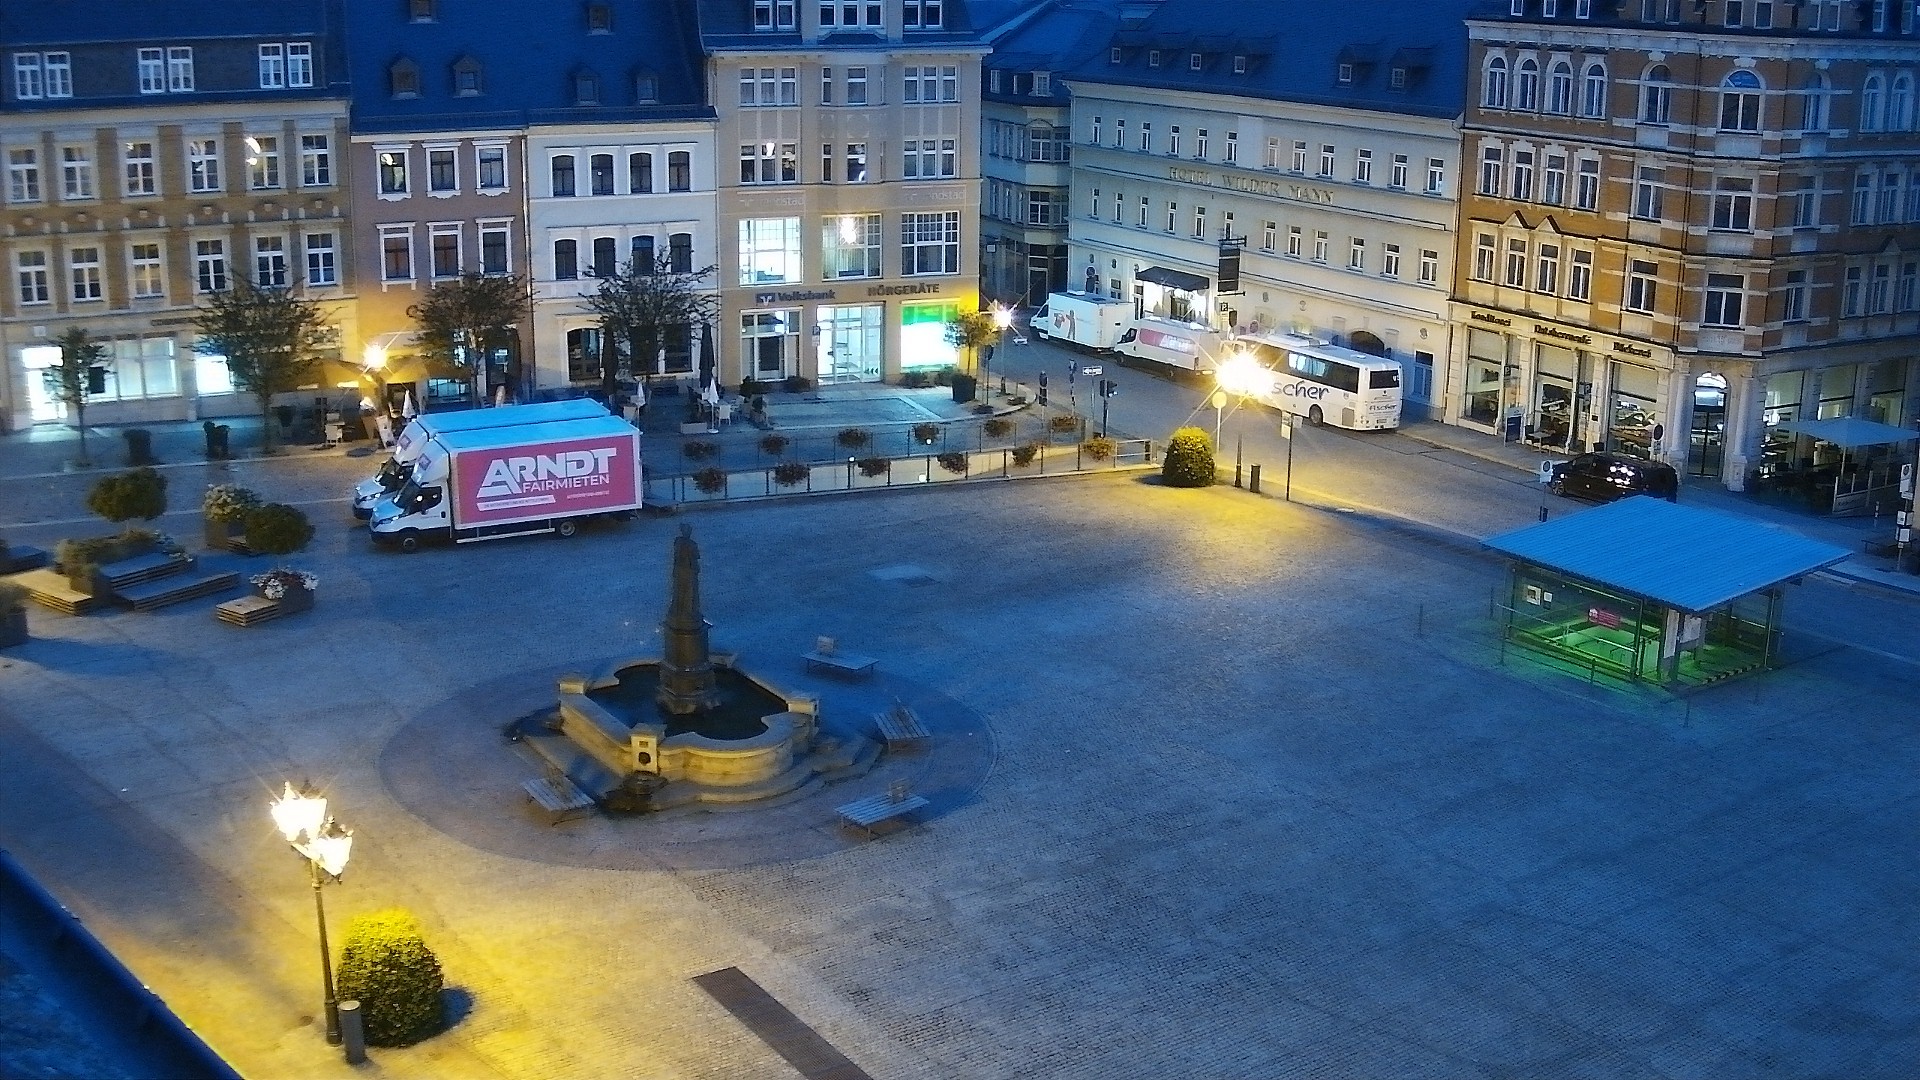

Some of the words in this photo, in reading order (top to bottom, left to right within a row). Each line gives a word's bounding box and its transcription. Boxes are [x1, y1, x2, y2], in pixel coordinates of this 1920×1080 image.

[1169, 166, 1214, 186] HOTEL
[1222, 174, 1280, 196] WILDER
[1288, 184, 1334, 205] MANN
[778, 289, 836, 302] Volksbank
[867, 282, 940, 297] HÖRGERÄTE
[1271, 380, 1330, 401] scher
[476, 447, 617, 498] ARNDT
[523, 473, 610, 493] FAIRMIETEN
